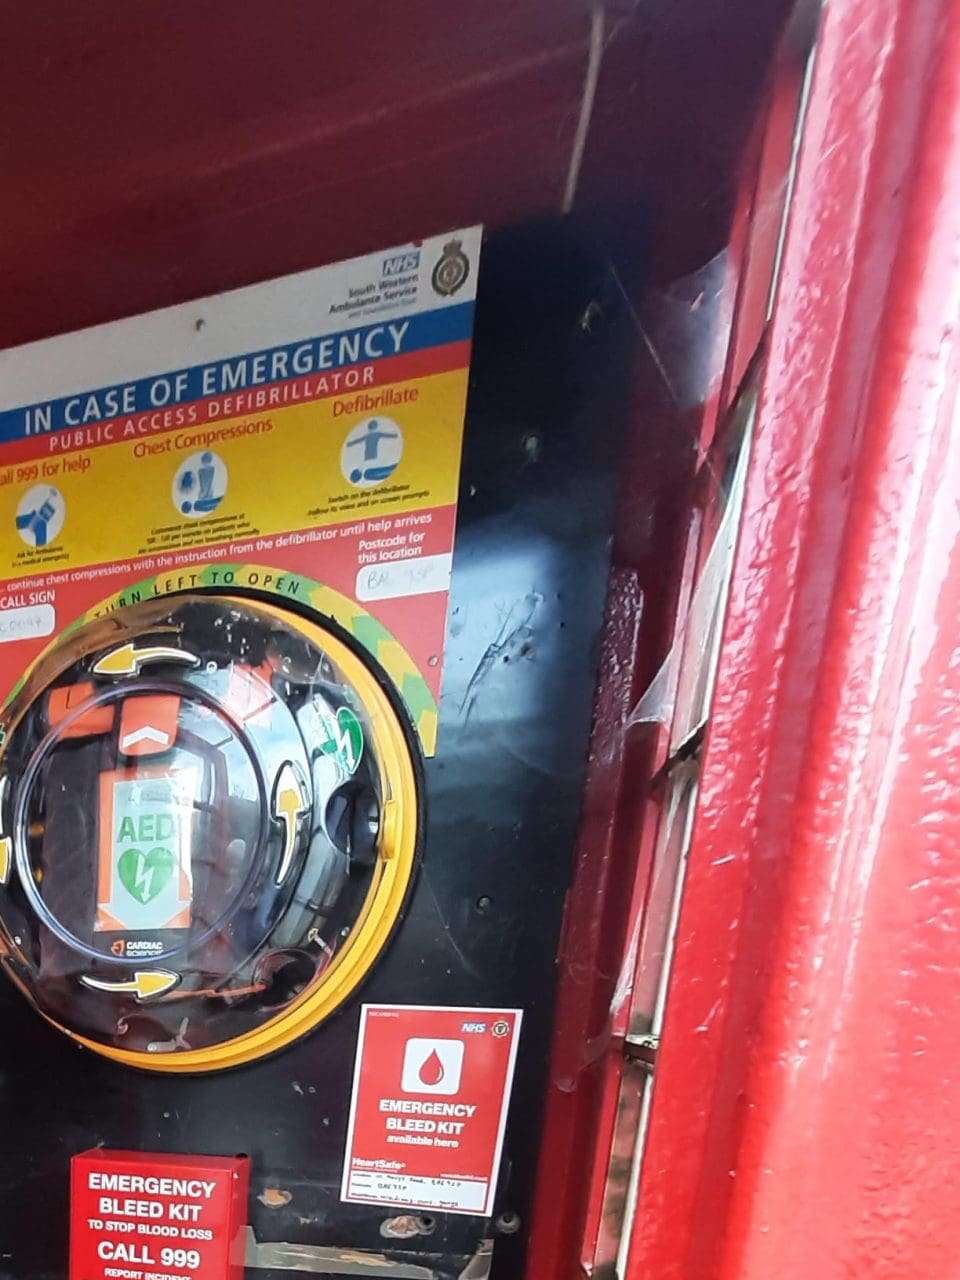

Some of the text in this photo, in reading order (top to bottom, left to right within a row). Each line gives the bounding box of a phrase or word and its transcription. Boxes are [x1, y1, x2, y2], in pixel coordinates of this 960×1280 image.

[383, 252, 420, 275] NHS
[329, 294, 380, 314] Ambulance
[384, 286, 417, 300] Service
[349, 284, 375, 298] South
[25, 321, 410, 435] IN CASE OF EMERGENCY
[49, 366, 375, 451] PUBLIC ACCESS DEFIBRILLATOR
[332, 387, 419, 417] Defibrillate
[134, 418, 273, 458] Chest Compressions
[16, 465, 39, 483] 999
[42, 461, 59, 477] for
[63, 455, 91, 474] help
[7, 578, 44, 592] continue
[46, 573, 69, 585] chest
[71, 562, 131, 581] compressions
[133, 557, 155, 571] with
[157, 554, 173, 566] the
[175, 547, 227, 564] instruction
[230, 543, 253, 555] from
[256, 540, 273, 551] the
[275, 529, 338, 548] defibrillator
[340, 524, 365, 537] until
[367, 519, 392, 532] help
[394, 513, 432, 528] arrives
[359, 531, 426, 551] Postcode for
[358, 545, 422, 565] this location
[0, 590, 56, 609] CALL SIGN
[94, 571, 300, 619] TURN LEFT TO OPEN
[117, 813, 176, 843] AED
[126, 941, 163, 951] CARDIAC
[461, 1023, 487, 1033] NHS
[379, 1099, 476, 1117] EMERGENCY
[386, 1118, 465, 1135] BLEED KIT
[386, 1135, 459, 1148] available here
[88, 1172, 216, 1198] EMERGENCY
[99, 1197, 202, 1222] BLEED KIT
[87, 1219, 213, 1240] TO STOP BLOOD LOSS
[97, 1241, 201, 1269] CALL 999
[104, 1267, 143, 1280] REPORT
